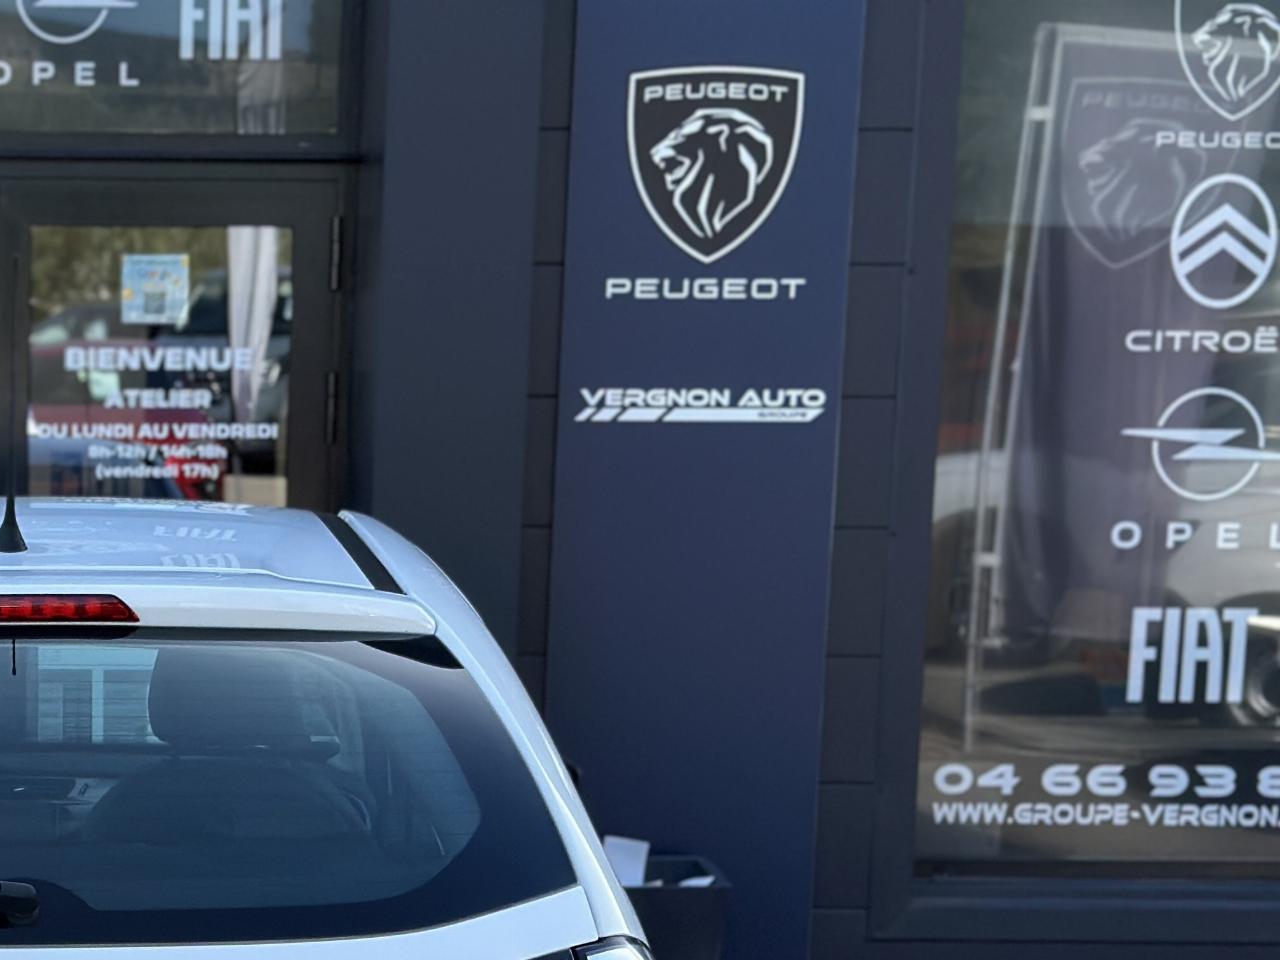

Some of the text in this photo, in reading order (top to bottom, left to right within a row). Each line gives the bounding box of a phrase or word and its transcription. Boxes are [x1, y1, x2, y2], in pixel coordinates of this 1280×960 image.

[643, 82, 789, 102] PEUGEOT
[605, 278, 806, 299] PEUGEOT
[64, 346, 255, 371] BIENVENUE
[104, 388, 213, 409] ATELIER
[580, 388, 827, 407] VERGNON AUTO
[72, 423, 134, 438] LUNDI
[138, 423, 169, 439] AU
[172, 423, 279, 440] VENDREDI
[1125, 607, 1260, 704] FIAT
[933, 763, 1020, 796] 04
[1041, 764, 1127, 797] 66
[1148, 765, 1238, 798] 93
